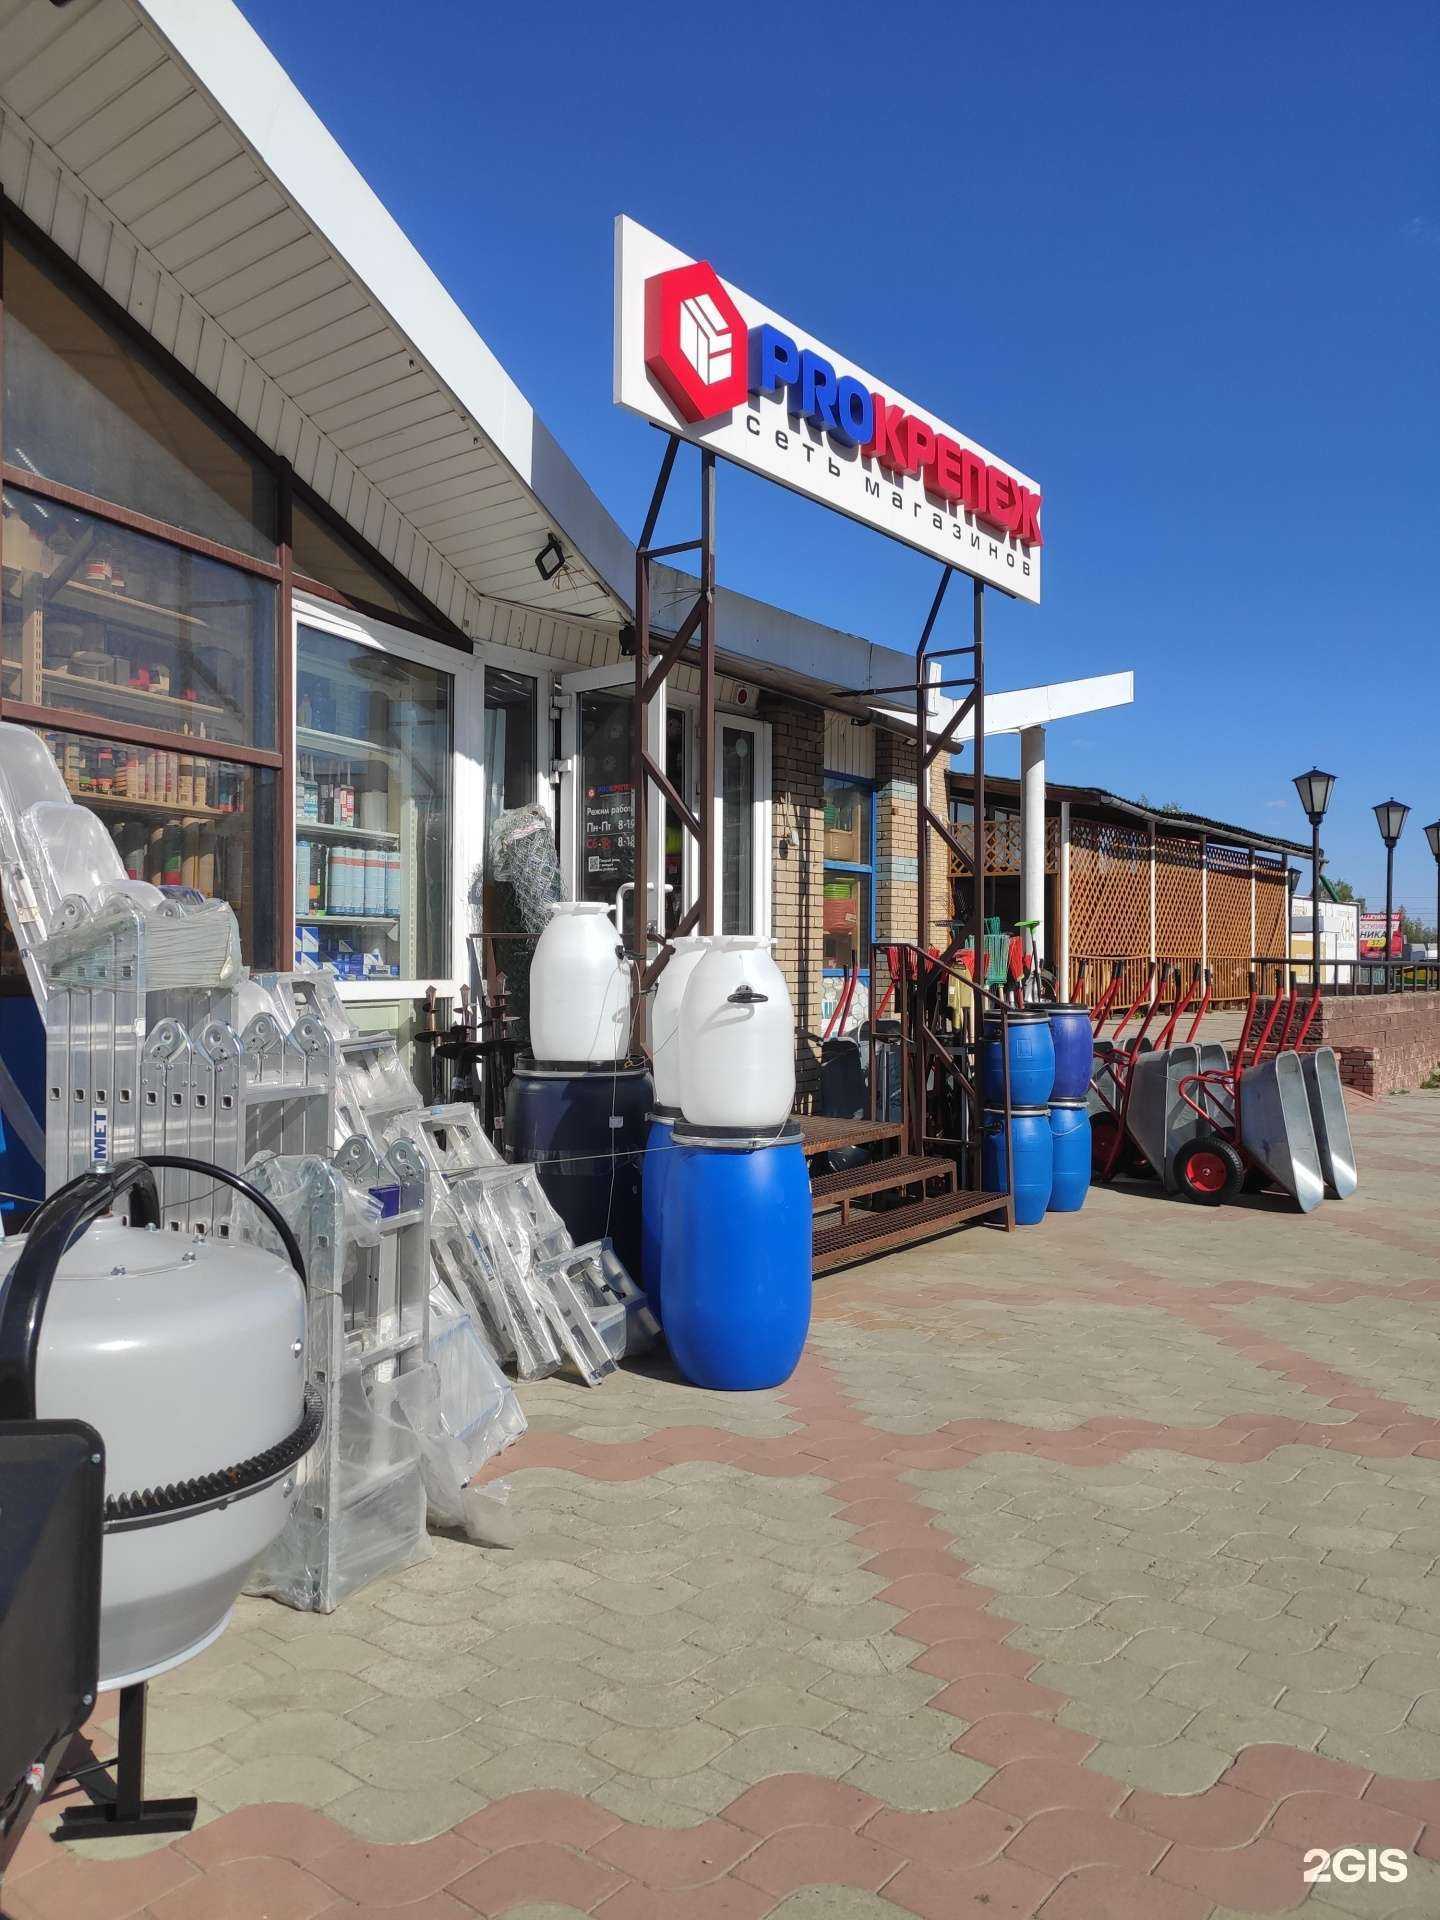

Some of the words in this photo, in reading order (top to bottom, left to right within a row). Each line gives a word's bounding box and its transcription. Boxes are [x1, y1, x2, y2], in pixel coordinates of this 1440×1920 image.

[746, 415, 841, 478] сеть
[865, 476, 1032, 577] магазинов
[586, 807, 610, 816] Режим
